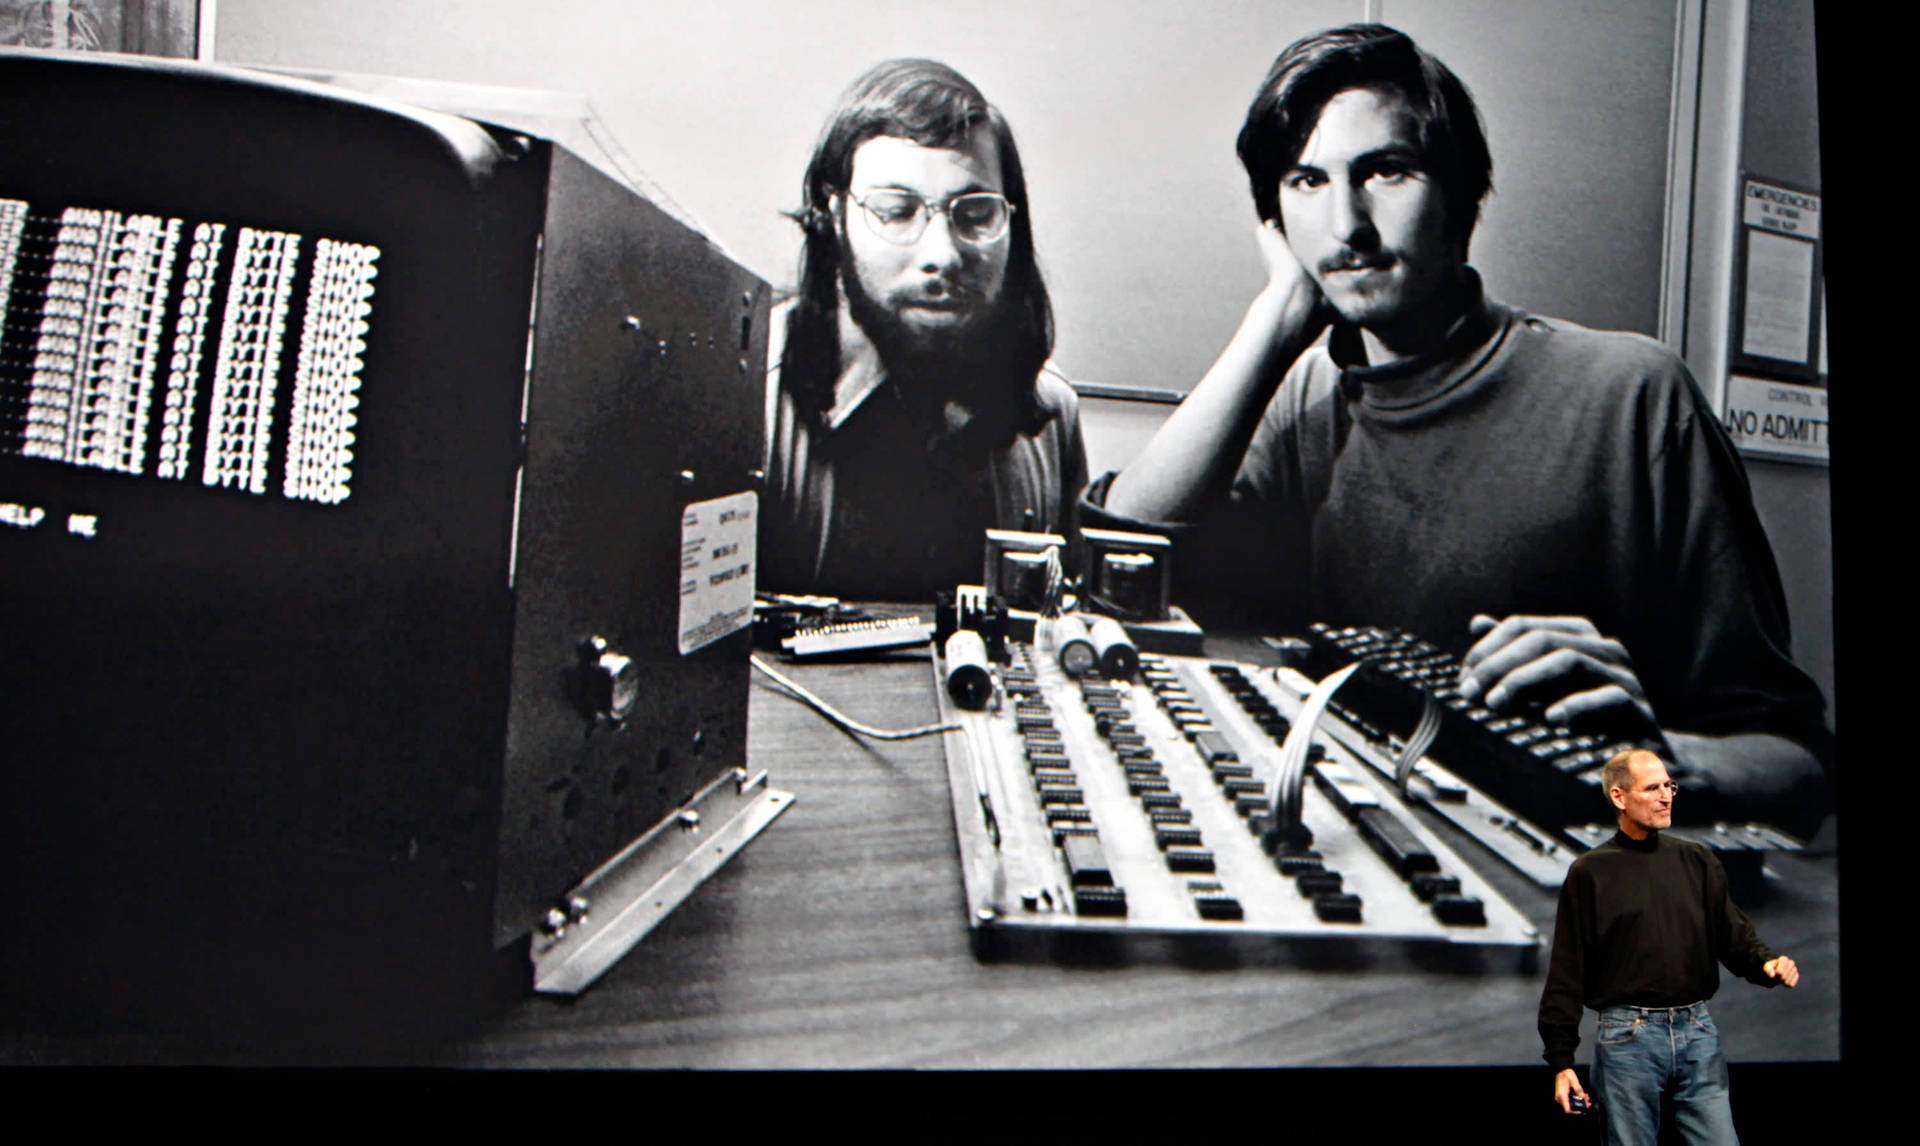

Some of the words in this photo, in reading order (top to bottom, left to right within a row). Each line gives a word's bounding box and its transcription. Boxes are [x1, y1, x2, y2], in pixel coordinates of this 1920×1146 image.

[191, 241, 222, 261] AT
[234, 246, 298, 272] BYTE
[313, 257, 378, 284] SHOP
[194, 222, 226, 243] AT
[238, 227, 302, 253] BYTE
[316, 238, 381, 265] SHOP
[186, 278, 215, 298] AT
[228, 283, 292, 309] BYTE
[307, 294, 372, 322] SHOP
[188, 260, 219, 280] AT
[231, 264, 295, 290] BYTE
[310, 275, 375, 303] SHOP
[180, 315, 209, 335] AT
[222, 320, 286, 346] BYTE
[301, 331, 367, 359] SHOP
[183, 297, 212, 317] AT
[225, 301, 289, 328] BYTE
[304, 312, 369, 341] SHOP
[174, 352, 203, 372] AT
[216, 356, 280, 384] BYTE
[296, 367, 362, 396] SHOP
[177, 333, 206, 354] AT
[219, 338, 283, 365] BYTE
[299, 349, 365, 378] SHOP
[168, 388, 198, 408] AT
[211, 392, 275, 421] BYTE
[291, 404, 358, 433] SHOP
[171, 370, 200, 390] AT
[214, 374, 278, 402] BYTE
[294, 386, 360, 415] SHOP
[166, 406, 195, 426] AT
[209, 410, 273, 439] BYTE
[289, 422, 356, 451] SHOP
[1727, 409, 1758, 435] NO
[160, 441, 191, 463] AT
[205, 446, 269, 476] BYTE
[285, 459, 353, 487] SHOP
[163, 424, 193, 444] AT
[207, 428, 271, 458] BYTE
[287, 441, 354, 469] SHOP
[157, 459, 189, 480] AT
[203, 464, 267, 495] BYTE
[283, 477, 351, 505] SHOP
[68, 513, 97, 537] ME
